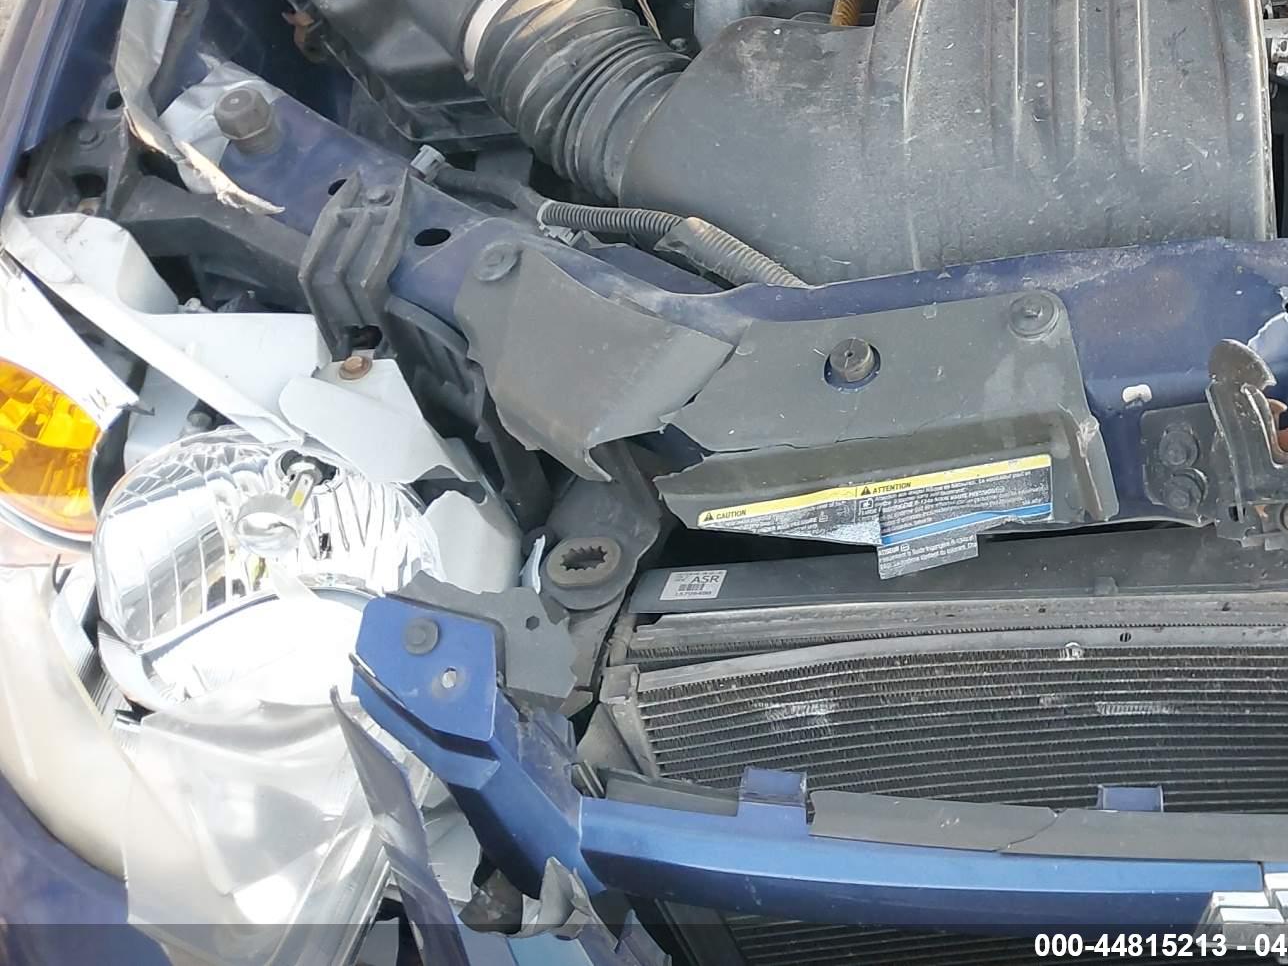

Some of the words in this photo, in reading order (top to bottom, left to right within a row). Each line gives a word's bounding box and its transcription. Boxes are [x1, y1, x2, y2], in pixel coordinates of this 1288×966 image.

[872, 481, 912, 495] ATTENTION
[716, 509, 747, 521] CAUTION
[690, 575, 720, 584] ASR
